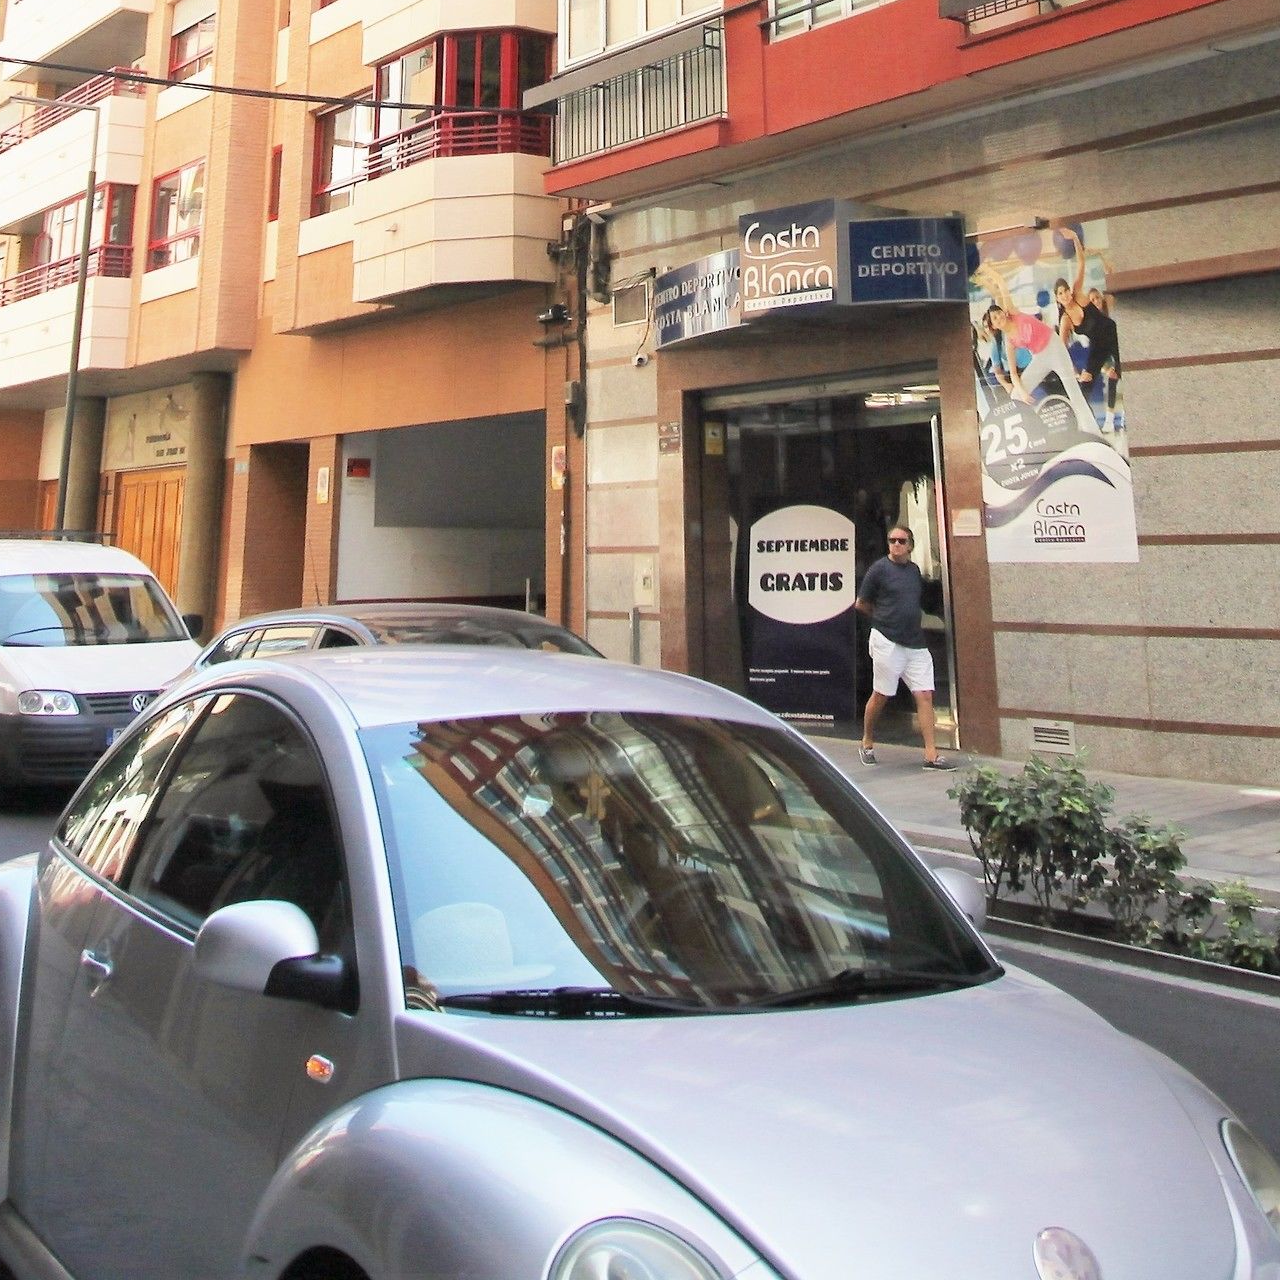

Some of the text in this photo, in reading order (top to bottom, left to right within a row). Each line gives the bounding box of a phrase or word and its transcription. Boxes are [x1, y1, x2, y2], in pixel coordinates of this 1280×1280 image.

[744, 221, 820, 255] Costa
[871, 244, 942, 259] CENTRO
[857, 261, 959, 278] DEPORTIVO
[744, 265, 834, 299] Blanca
[1036, 498, 1080, 516] Costa
[1033, 520, 1086, 537] Blanca
[757, 538, 849, 553] SEPTIEMBRE
[760, 572, 844, 592] GRATIS
